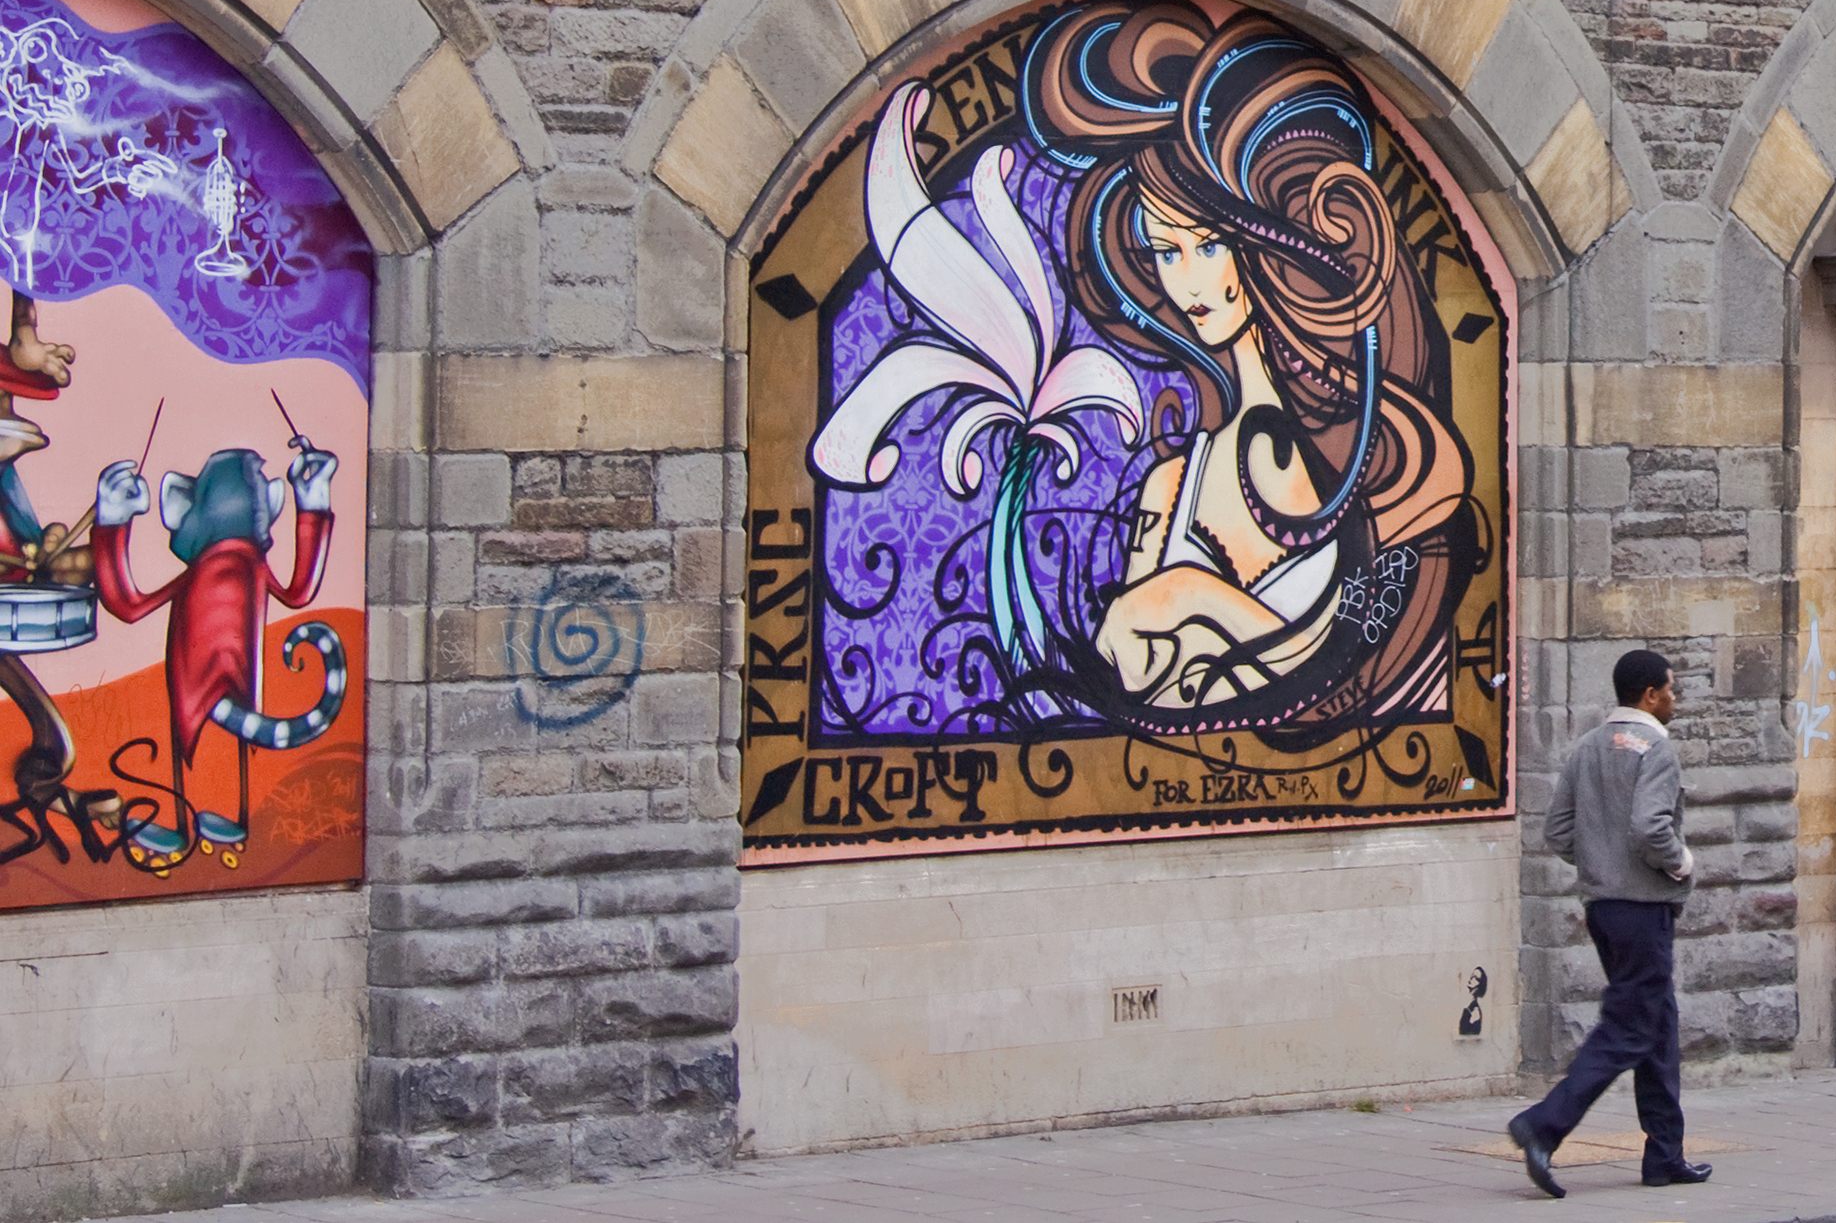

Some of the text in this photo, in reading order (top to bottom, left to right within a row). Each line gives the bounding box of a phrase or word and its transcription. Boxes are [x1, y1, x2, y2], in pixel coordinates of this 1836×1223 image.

[748, 507, 812, 748] PRSC
[802, 748, 999, 827] CROFT
[1201, 774, 1276, 805] EZRA
